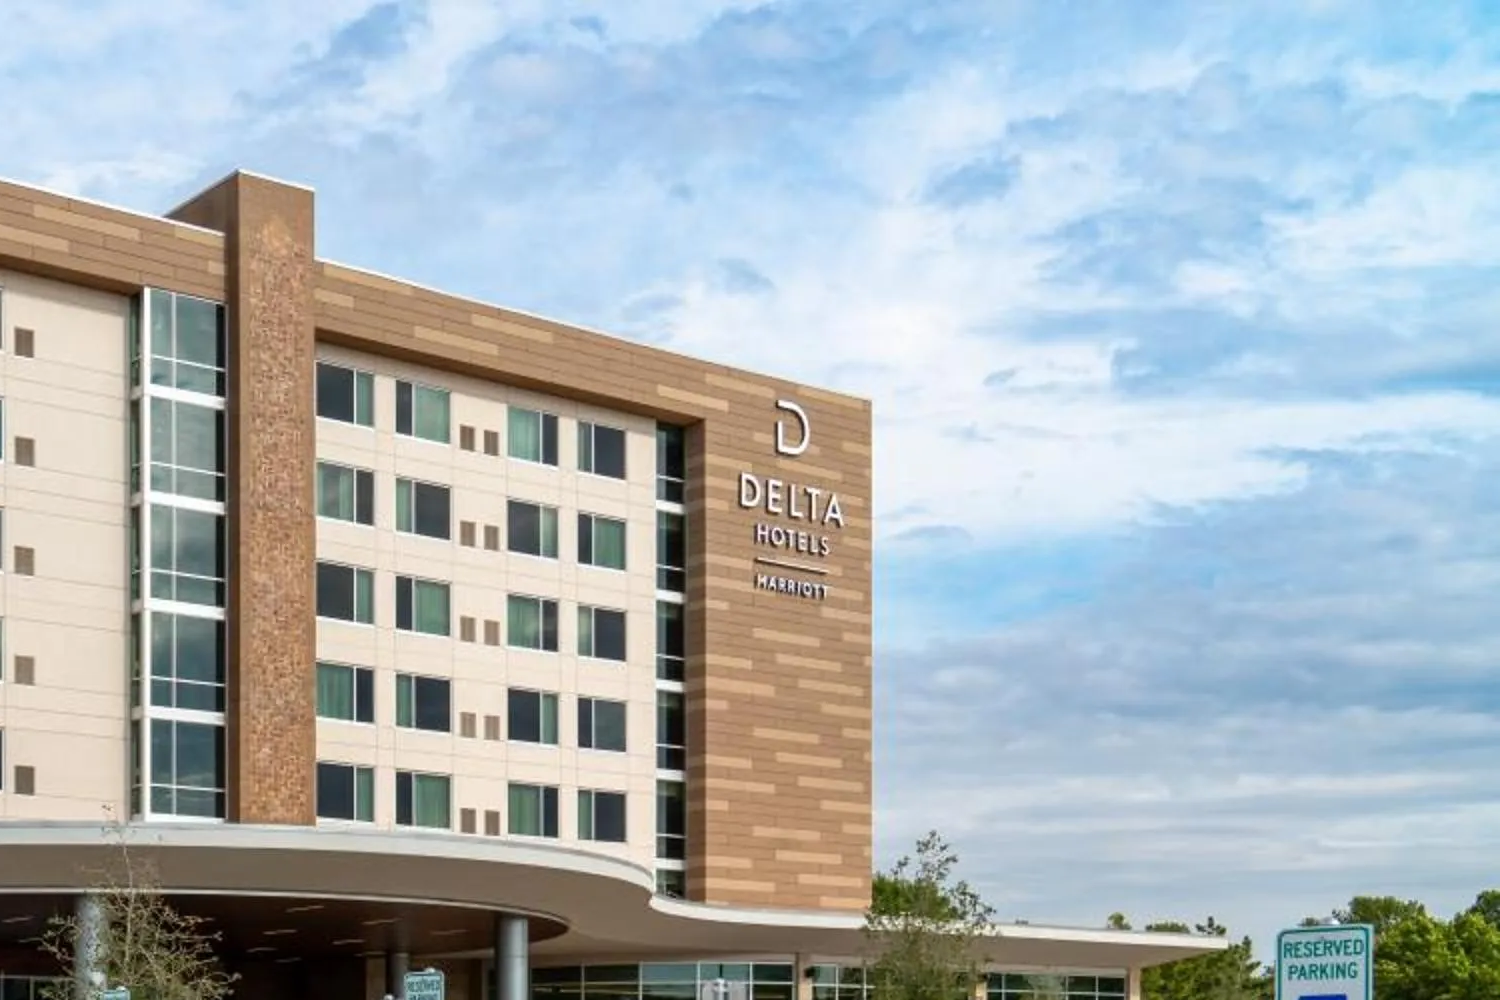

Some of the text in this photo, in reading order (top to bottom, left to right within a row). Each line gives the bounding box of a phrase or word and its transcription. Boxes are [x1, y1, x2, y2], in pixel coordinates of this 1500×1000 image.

[739, 471, 844, 527] DELTA
[755, 523, 829, 556] HOTELS
[756, 574, 829, 598] MARRIOTT
[1283, 939, 1365, 959] RESERVED
[1288, 962, 1359, 981] PARKING
